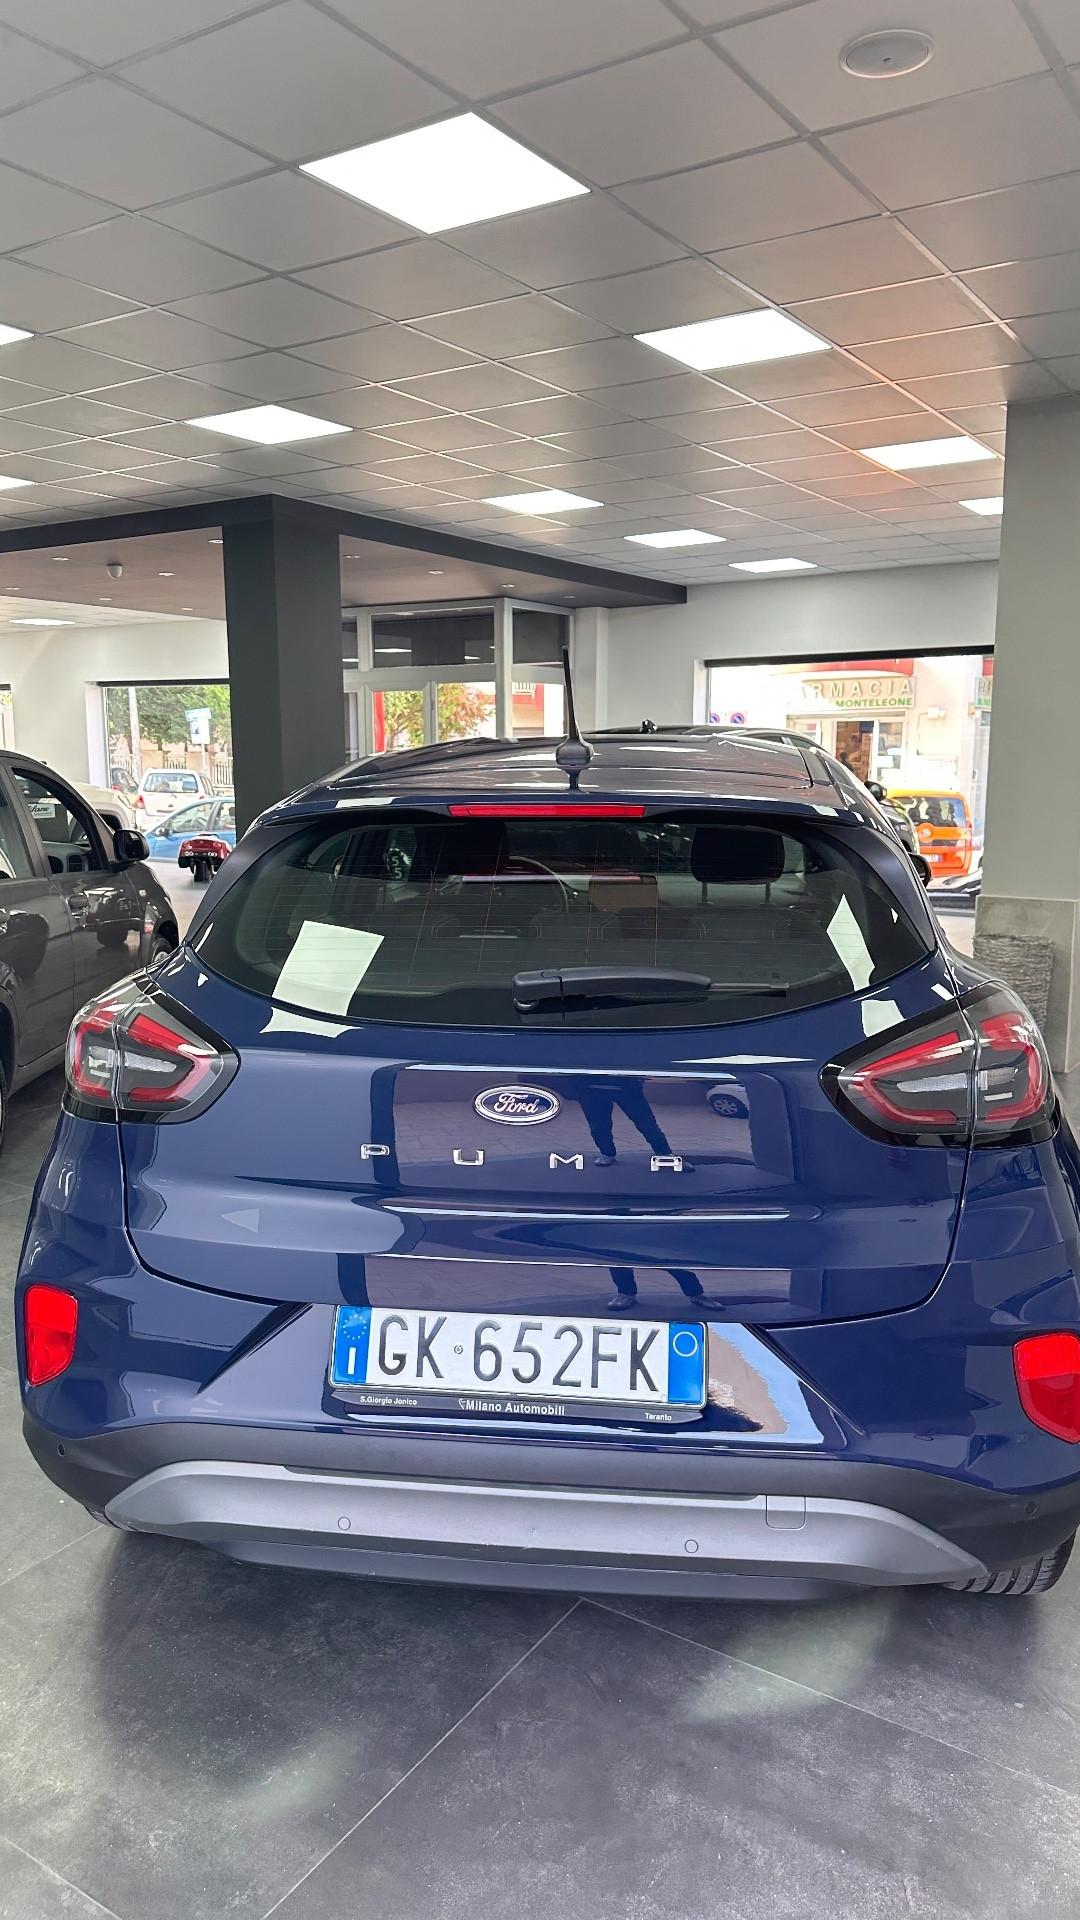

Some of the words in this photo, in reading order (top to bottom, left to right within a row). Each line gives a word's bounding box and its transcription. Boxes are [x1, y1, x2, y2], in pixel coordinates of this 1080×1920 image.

[802, 679, 914, 699] RMACIA
[493, 1092, 540, 1114] Ford
[360, 1143, 683, 1172] PUMA
[393, 1397, 418, 1406] Jonico
[465, 1399, 502, 1412] Milano
[504, 1402, 565, 1416] Automobili
[644, 1412, 673, 1421] Taranto
